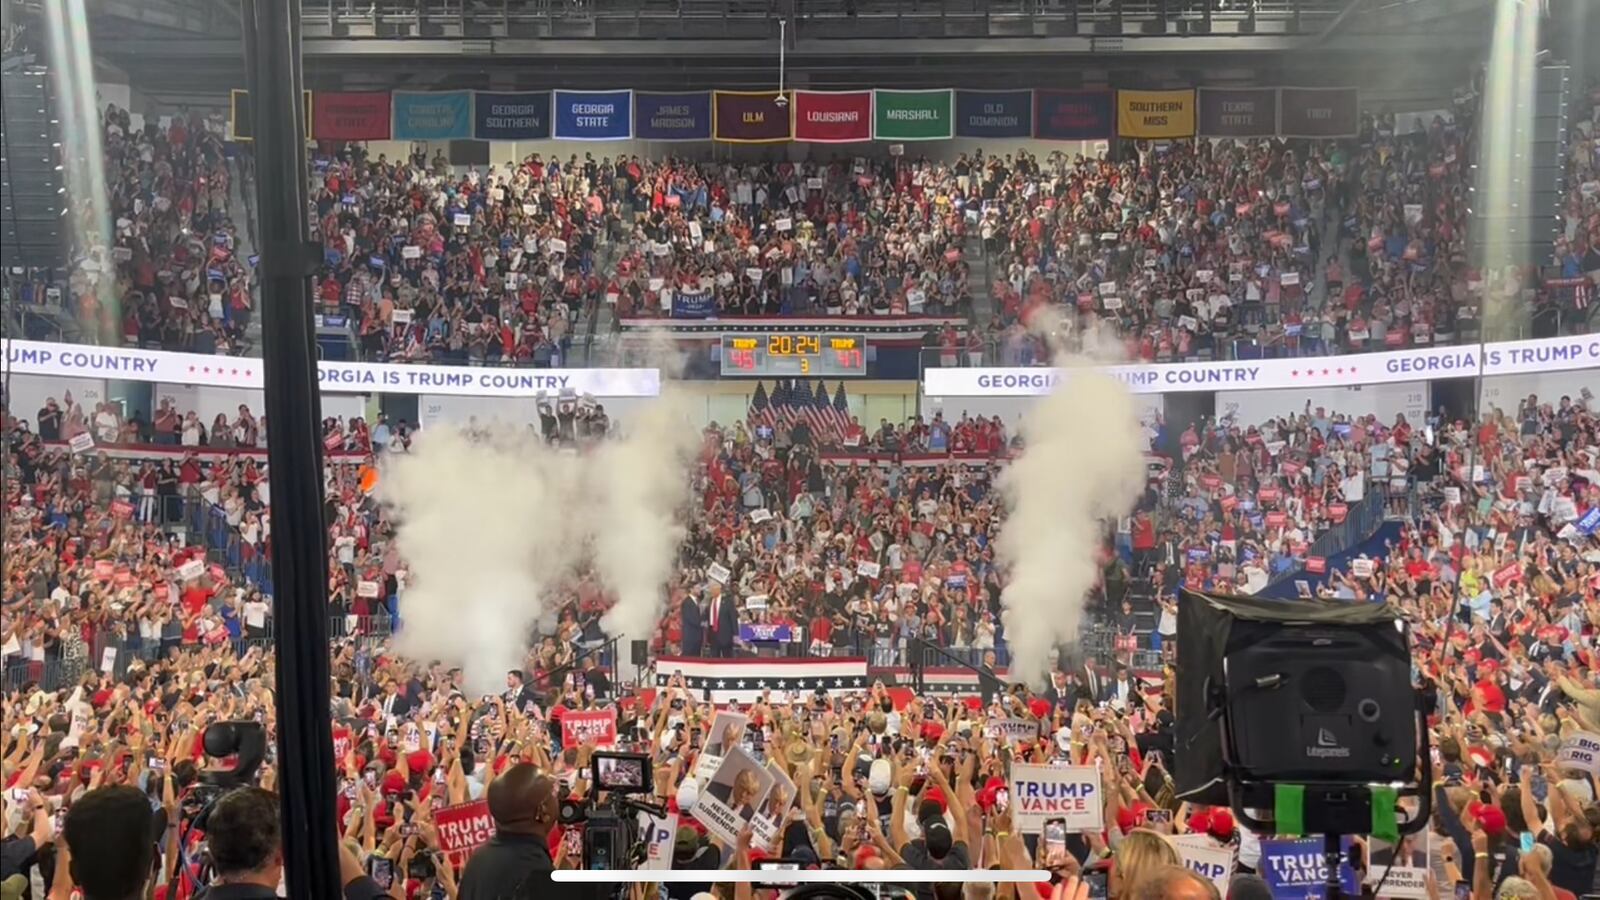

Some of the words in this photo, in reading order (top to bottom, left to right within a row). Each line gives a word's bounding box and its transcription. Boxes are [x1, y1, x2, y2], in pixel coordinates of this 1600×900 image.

[491, 104, 534, 115] GEORGIA
[571, 103, 614, 115] GEORGIA
[656, 105, 689, 116] JAMES
[983, 103, 1004, 114] OLD
[1128, 101, 1183, 113] SOUTHERN
[1221, 101, 1255, 113] TEXAS
[1306, 107, 1333, 119] TROY
[742, 112, 764, 123] ULM
[806, 111, 859, 123] LOUISIANA
[886, 109, 940, 120] MARSHALL
[1143, 115, 1168, 126] MISS
[1220, 114, 1254, 126] STATE
[486, 117, 540, 128] SOUTHERN
[576, 116, 610, 128] STATE
[650, 118, 696, 129] MADISON
[969, 115, 1018, 127] DOMINION
[732, 338, 758, 349] TRUMP
[769, 335, 818, 354] 20:24
[830, 338, 856, 349] TRUMP
[1, 349, 52, 365] UMP
[59, 352, 159, 374] COUNTRY
[730, 350, 754, 369] 45
[838, 350, 862, 369] 47
[1386, 352, 1476, 374] GEORGIA
[1482, 350, 1501, 366] IS
[1508, 344, 1583, 366] TRUMP
[800, 358, 809, 373] 3
[317, 369, 375, 384] ORGIA
[382, 371, 401, 385] IS
[407, 372, 474, 388] TRUMP
[479, 374, 569, 392] COUNTRY
[1110, 370, 1159, 386] UMP
[1165, 366, 1262, 386] COUNTRY
[566, 718, 612, 729] TRUMP
[1578, 738, 1600, 751] BIG
[1305, 746, 1350, 759] Litepanels
[1571, 750, 1593, 762] RIG
[1015, 780, 1095, 798] TRUMP
[1021, 797, 1086, 811] VANCE
[710, 802, 737, 825] NEVER
[753, 815, 770, 831] EVER
[1279, 864, 1341, 882] VANC
[1386, 871, 1413, 880] EVER
